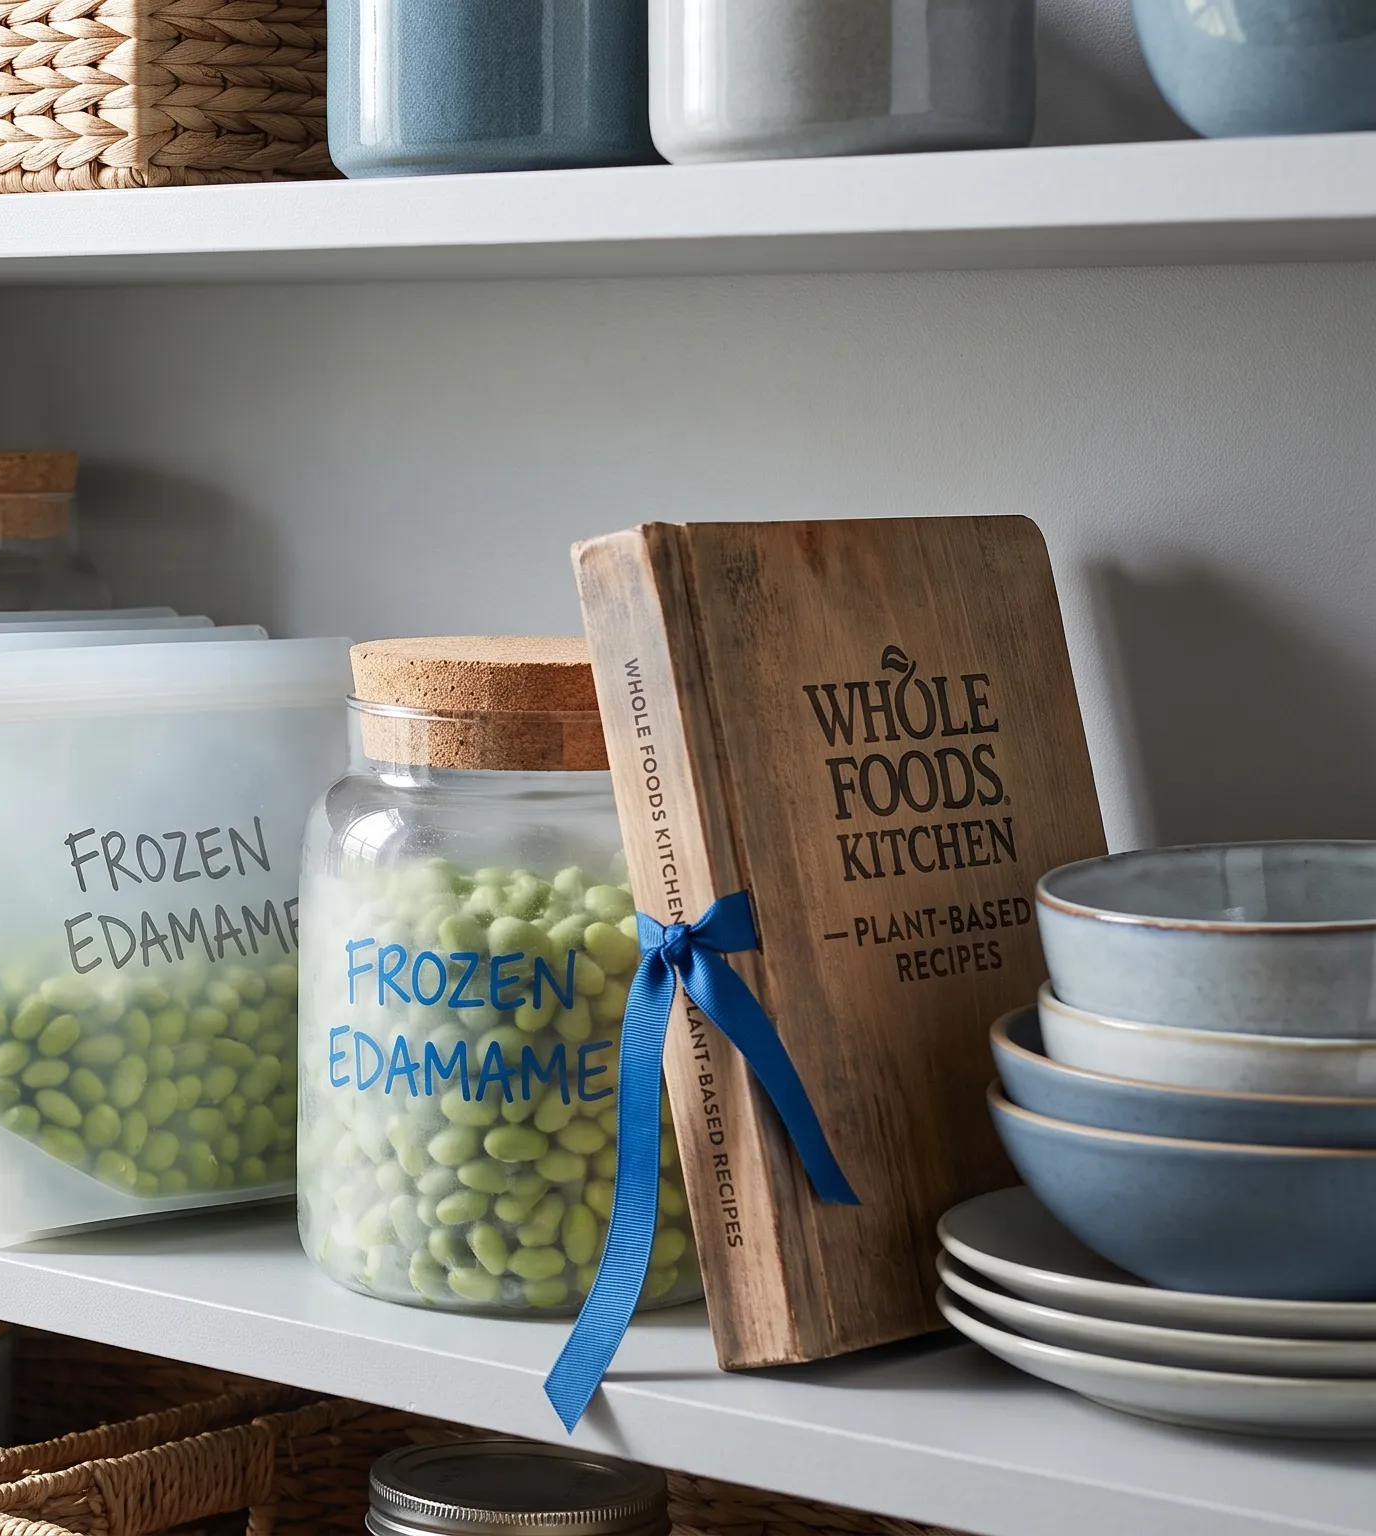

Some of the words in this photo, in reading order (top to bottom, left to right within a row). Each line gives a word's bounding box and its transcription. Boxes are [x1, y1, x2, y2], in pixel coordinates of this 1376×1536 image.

[802, 660, 1000, 747] WHOLE
[624, 657, 652, 738] WHOLE
[640, 744, 666, 822] FOODS
[655, 827, 686, 925] KITCHEN
[64, 815, 272, 892] FROZEN
[836, 817, 1018, 881] KITCHEN
[345, 937, 577, 1011] FROZEN
[895, 941, 1003, 982] RECIPES
[328, 1024, 614, 1106] EDAMAME
[713, 1152, 743, 1248] RECIPES
